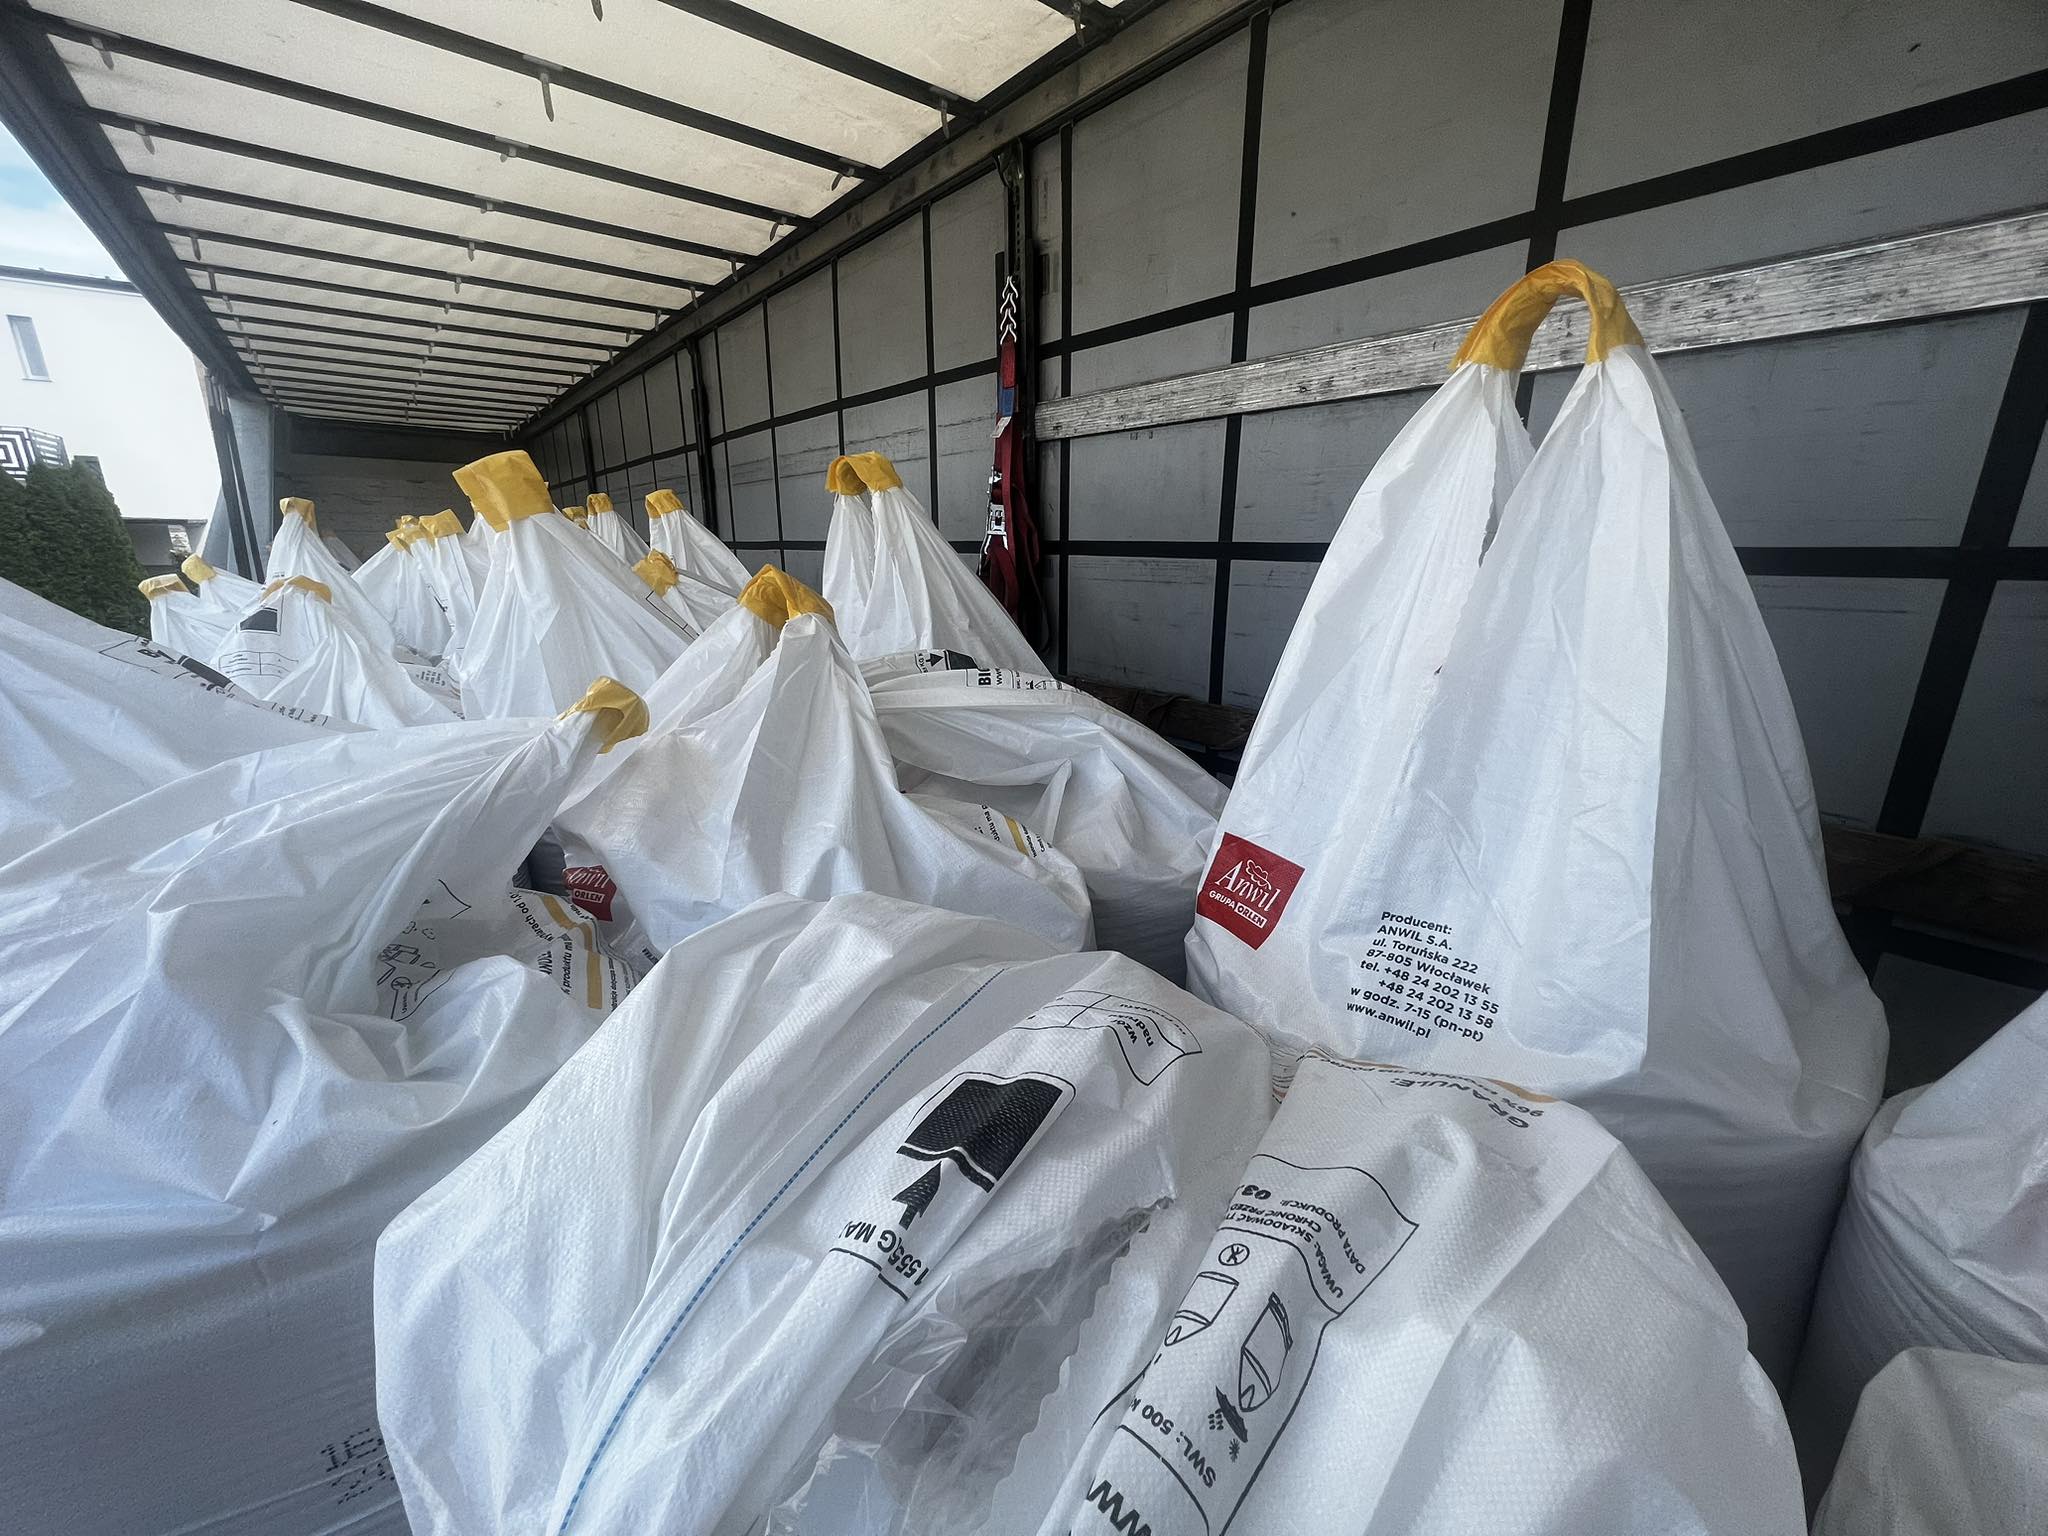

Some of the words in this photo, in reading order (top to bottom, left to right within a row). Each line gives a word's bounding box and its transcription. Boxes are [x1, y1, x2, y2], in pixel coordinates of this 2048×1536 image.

[573, 890, 603, 902] ORLEN
[1214, 860, 1281, 911] Anwil
[519, 900, 529, 914] od
[1209, 890, 1236, 909] GRUPA
[1236, 904, 1265, 926] ORLEN
[1381, 911, 1452, 935] Producent:
[1372, 938, 1387, 948] ul.
[1392, 940, 1449, 964] Toruńska
[1451, 958, 1479, 974] 222
[1377, 925, 1422, 942] ANWIL
[1426, 935, 1452, 950] S.A.
[1360, 960, 1380, 972] tel.
[1384, 966, 1410, 981] +48
[1412, 975, 1430, 988] 24
[1432, 982, 1460, 999] 202
[1463, 993, 1478, 1006] 13
[1480, 1001, 1499, 1015] 55
[1366, 949, 1412, 967] 87-805
[1416, 961, 1491, 994] Włocławek
[1346, 1002, 1431, 1039] www.anwil.pl
[1350, 987, 1361, 996] w
[1363, 990, 1400, 1009] godz.
[1403, 1002, 1431, 1020] 7-15
[1434, 1015, 1484, 1042] (pn-pt)
[1378, 979, 1404, 994] +48
[1406, 988, 1424, 1001] 24
[1426, 996, 1454, 1014] 202
[1457, 1007, 1473, 1020] 13
[1475, 1015, 1493, 1029] 58
[1390, 1078, 1529, 1129] GRANULE:
[1230, 1203, 1265, 1215] PRZED
[1236, 1212, 1314, 1243] SKŁADOWAĆ
[1265, 1209, 1322, 1233] CHRONIĆ
[1280, 1200, 1346, 1239] PRODUKCJI:
[1314, 1241, 1344, 1298] UWAGA:
[1343, 1238, 1366, 1275] DATA
[1141, 1404, 1175, 1435] 500
[1176, 1431, 1217, 1488] SWL:
